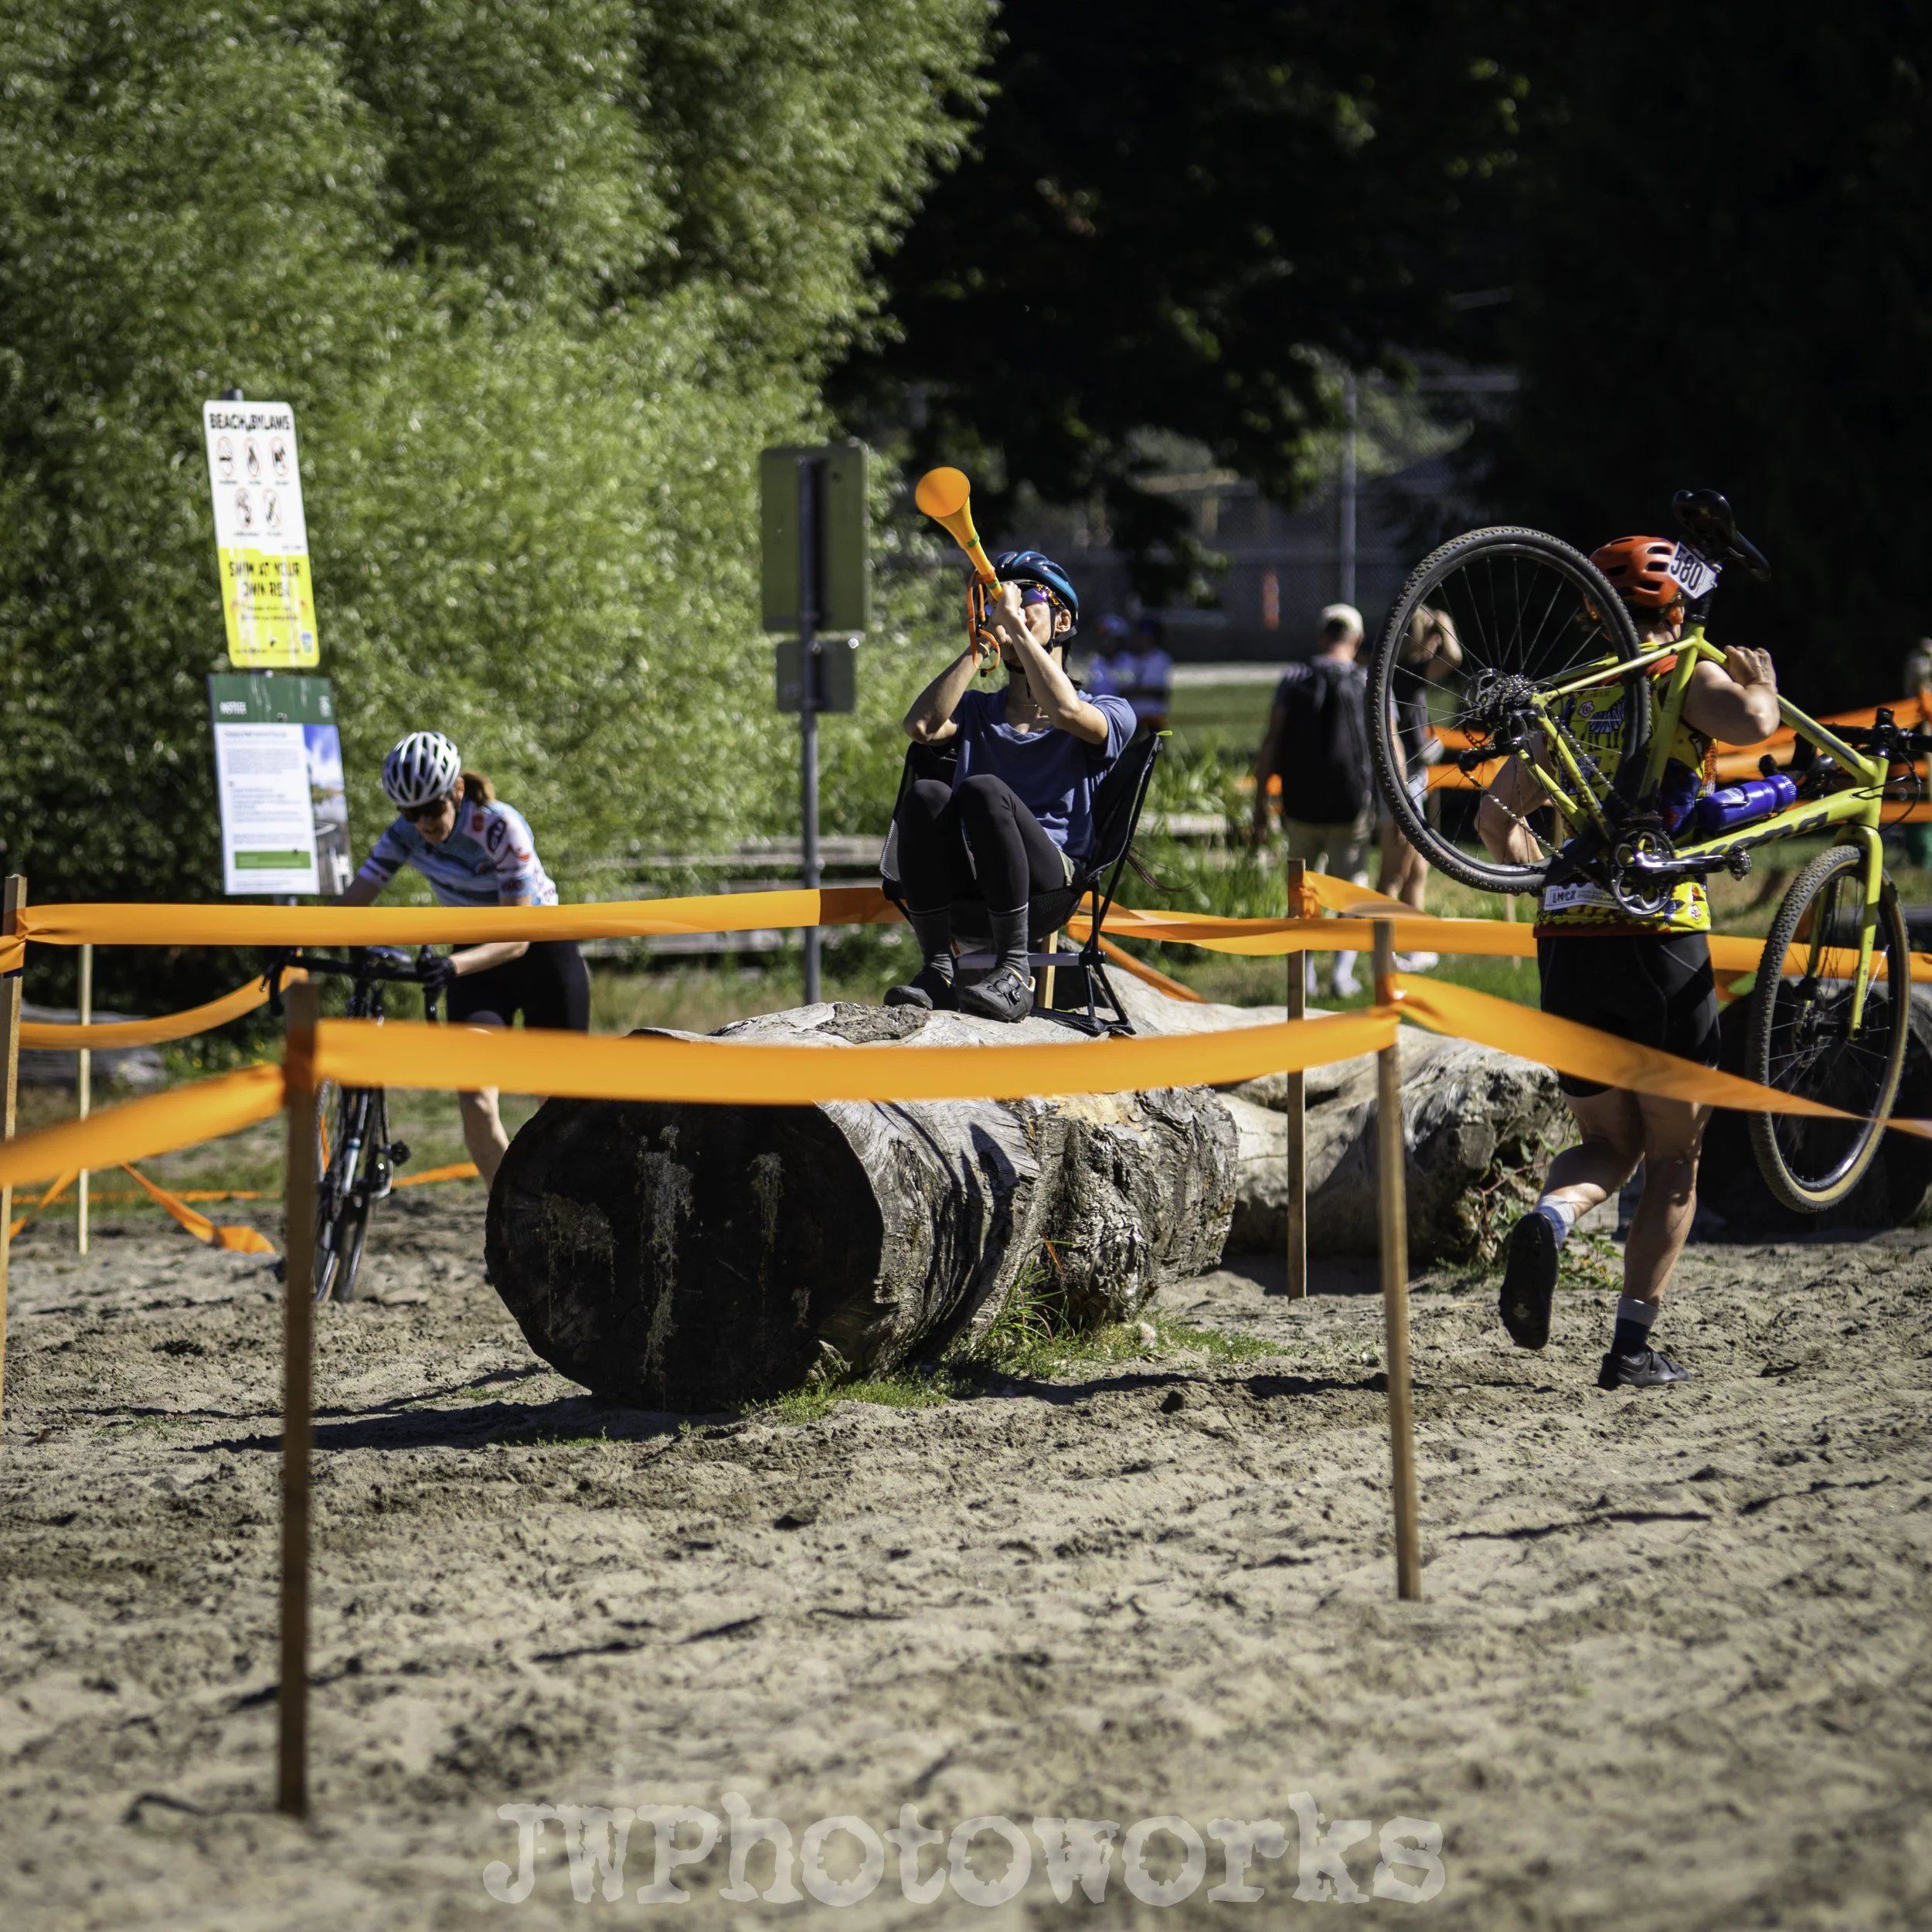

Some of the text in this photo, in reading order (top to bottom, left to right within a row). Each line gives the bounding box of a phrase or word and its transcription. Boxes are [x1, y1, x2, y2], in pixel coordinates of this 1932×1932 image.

[209, 413, 291, 430] BEACH BYLAWS
[228, 561, 254, 577] SWIM
[1670, 549, 1704, 591] 580
